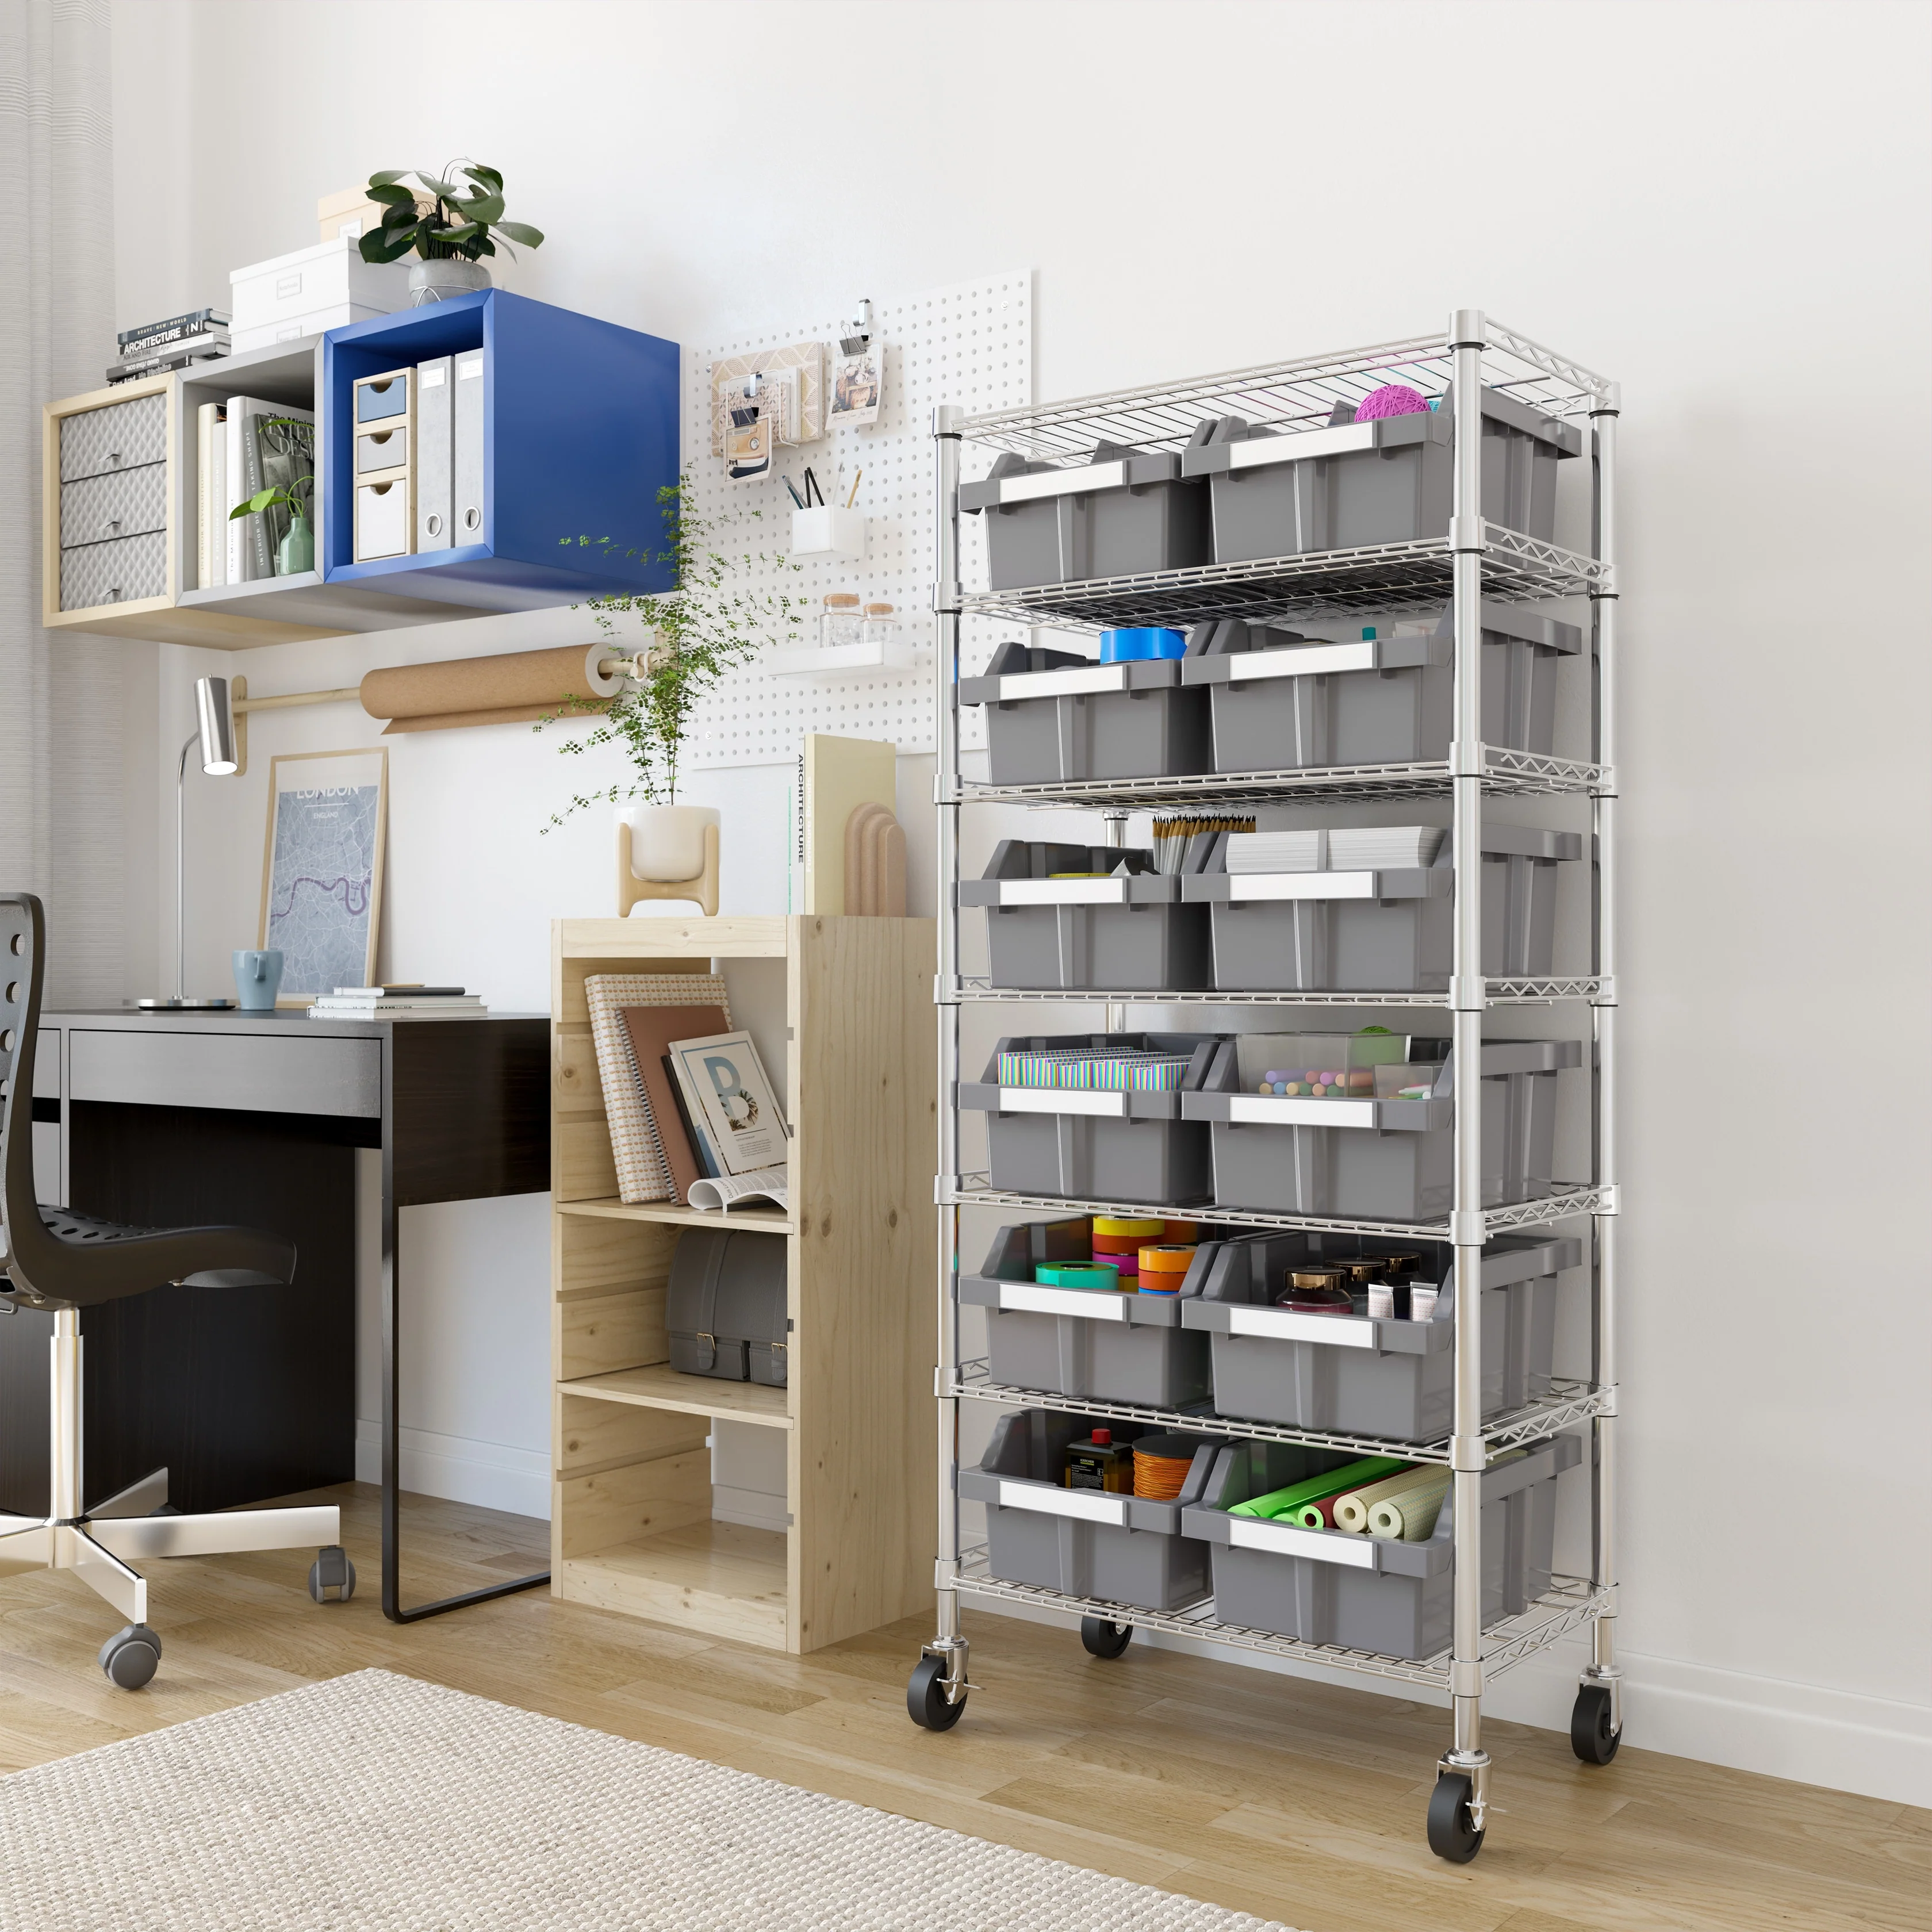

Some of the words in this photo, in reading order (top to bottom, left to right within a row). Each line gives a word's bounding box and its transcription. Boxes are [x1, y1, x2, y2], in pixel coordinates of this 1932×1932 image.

[170, 317, 187, 326] WORLD
[124, 327, 181, 355] ARCHITECTURE
[297, 787, 359, 799] LONDON
[703, 1056, 759, 1132] B
